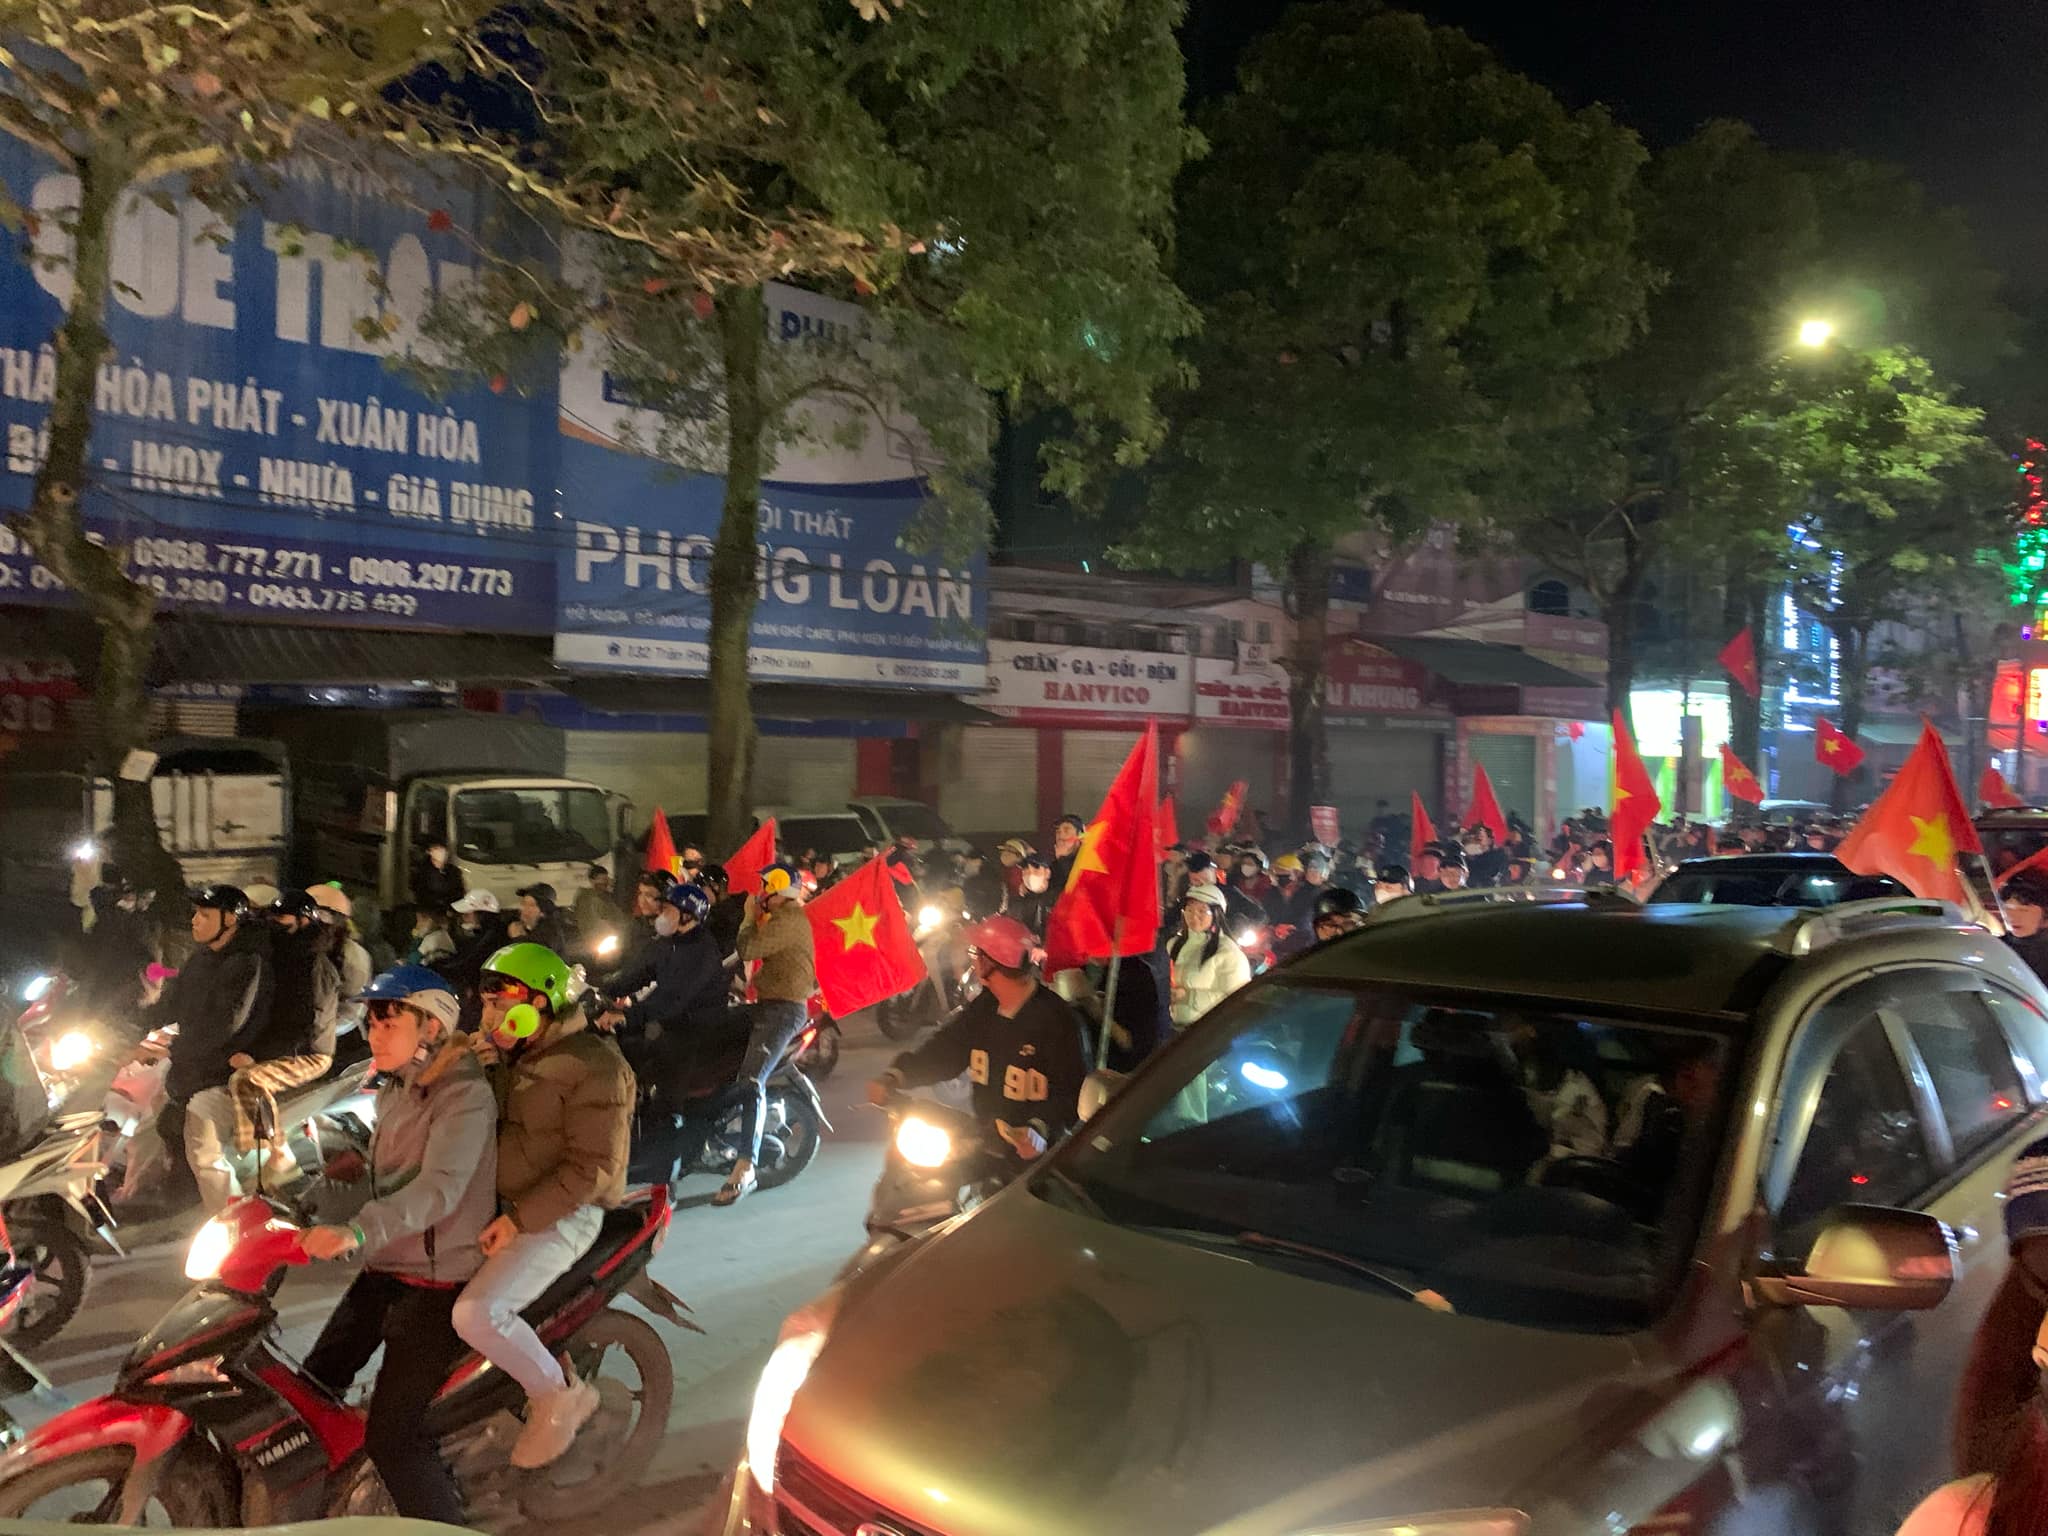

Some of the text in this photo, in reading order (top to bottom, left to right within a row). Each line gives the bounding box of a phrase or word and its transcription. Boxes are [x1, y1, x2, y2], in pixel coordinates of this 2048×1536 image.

[96, 355, 176, 422] HÒA
[187, 376, 283, 436] PHÁT
[316, 395, 409, 455] XUÂN
[417, 405, 480, 464] HÒA
[131, 439, 224, 498] INOX
[450, 480, 534, 536] DỤNG
[756, 498, 853, 540] ỘI THẤT
[350, 556, 514, 597] 0906.297.773
[829, 552, 972, 620] LOAN
[1043, 681, 1151, 705] HANVICO
[256, 1432, 309, 1466] YAMAHA
